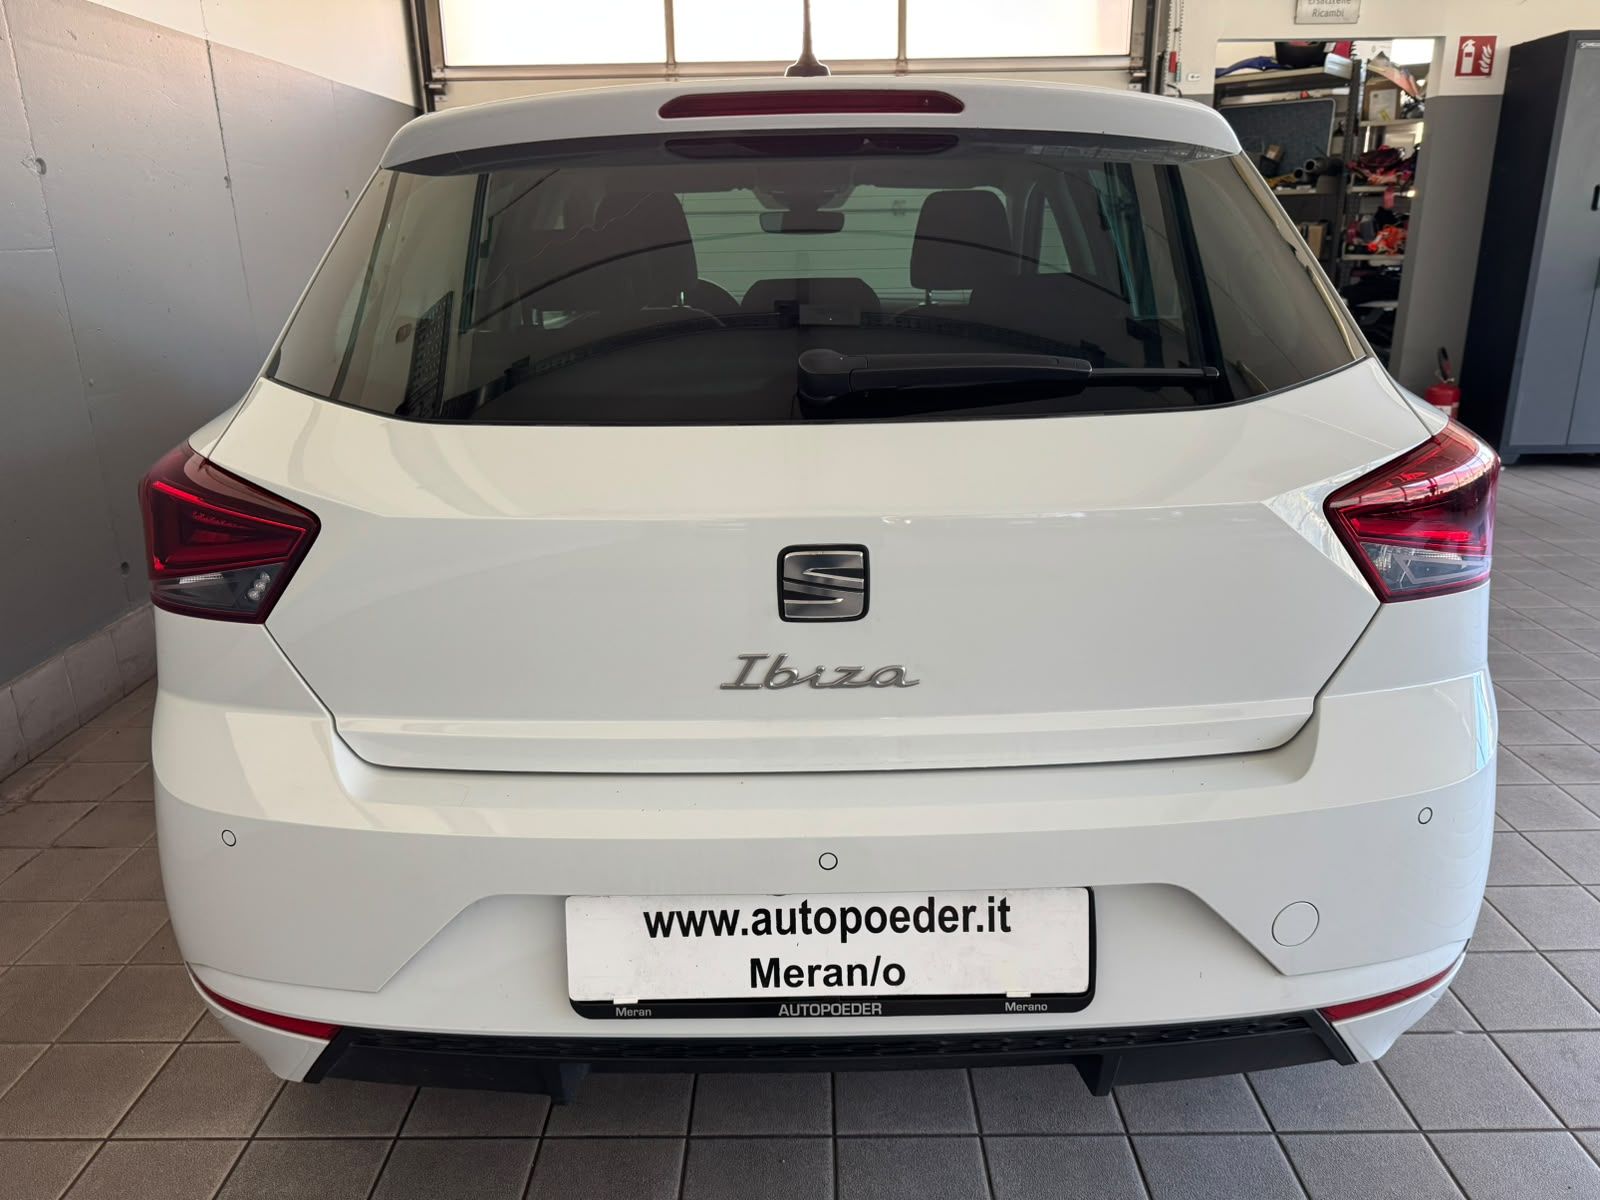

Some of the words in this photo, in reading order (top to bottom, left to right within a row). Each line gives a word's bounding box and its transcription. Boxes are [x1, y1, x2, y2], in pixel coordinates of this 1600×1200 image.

[1312, 8, 1345, 17] Ricambi
[719, 652, 921, 690] Ibiza
[643, 896, 1012, 943] www.autopoeder.it
[749, 955, 906, 989] Meran/o
[615, 1007, 652, 1017] Meran
[778, 1002, 882, 1016] AUTOPOEDER
[1004, 1001, 1048, 1012] Merano
